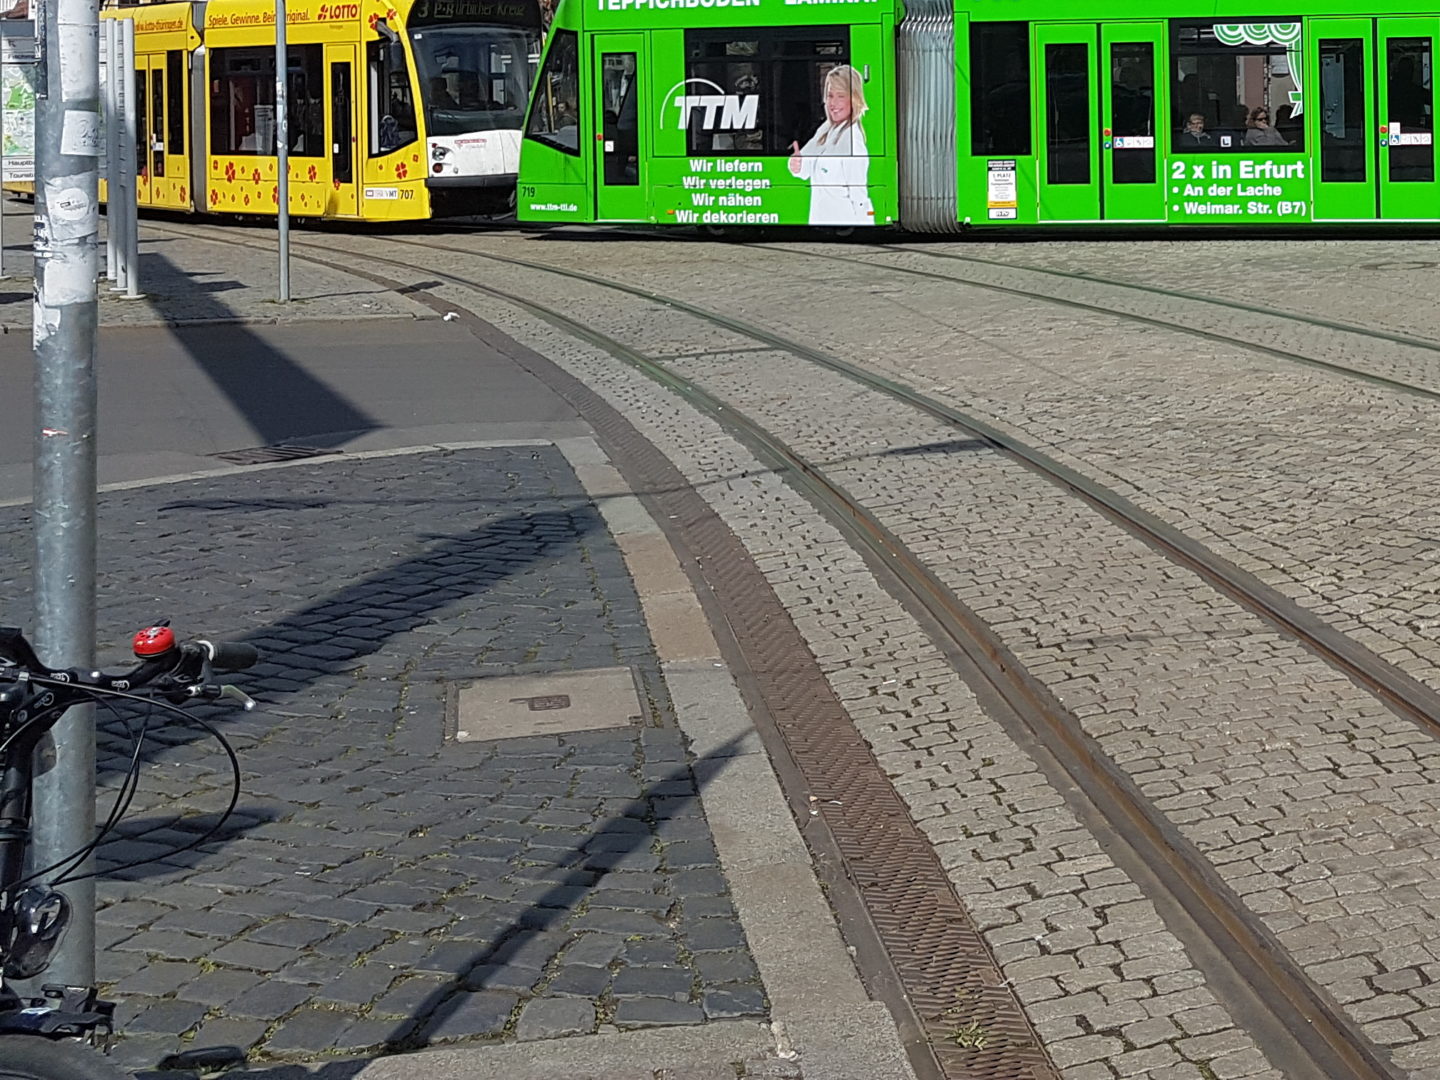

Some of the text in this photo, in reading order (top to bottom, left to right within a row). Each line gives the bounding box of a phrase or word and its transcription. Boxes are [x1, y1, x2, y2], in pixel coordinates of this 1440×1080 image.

[286, 7, 310, 24] riginal.
[329, 4, 358, 19] LOTTO
[417, 0, 429, 18] 3
[673, 94, 760, 131] TTM
[689, 159, 763, 172] Wir liefern
[1171, 160, 1304, 179] 2 x in Erfurt
[522, 186, 535, 197] 719
[682, 176, 770, 192] Wir verlegen
[1183, 184, 1282, 196] An der Lache
[399, 189, 415, 200] 707
[691, 193, 762, 206] Wir nähen
[675, 209, 779, 223] Wir dekorieren
[1184, 201, 1306, 216] Weimar. Str. (B7)
